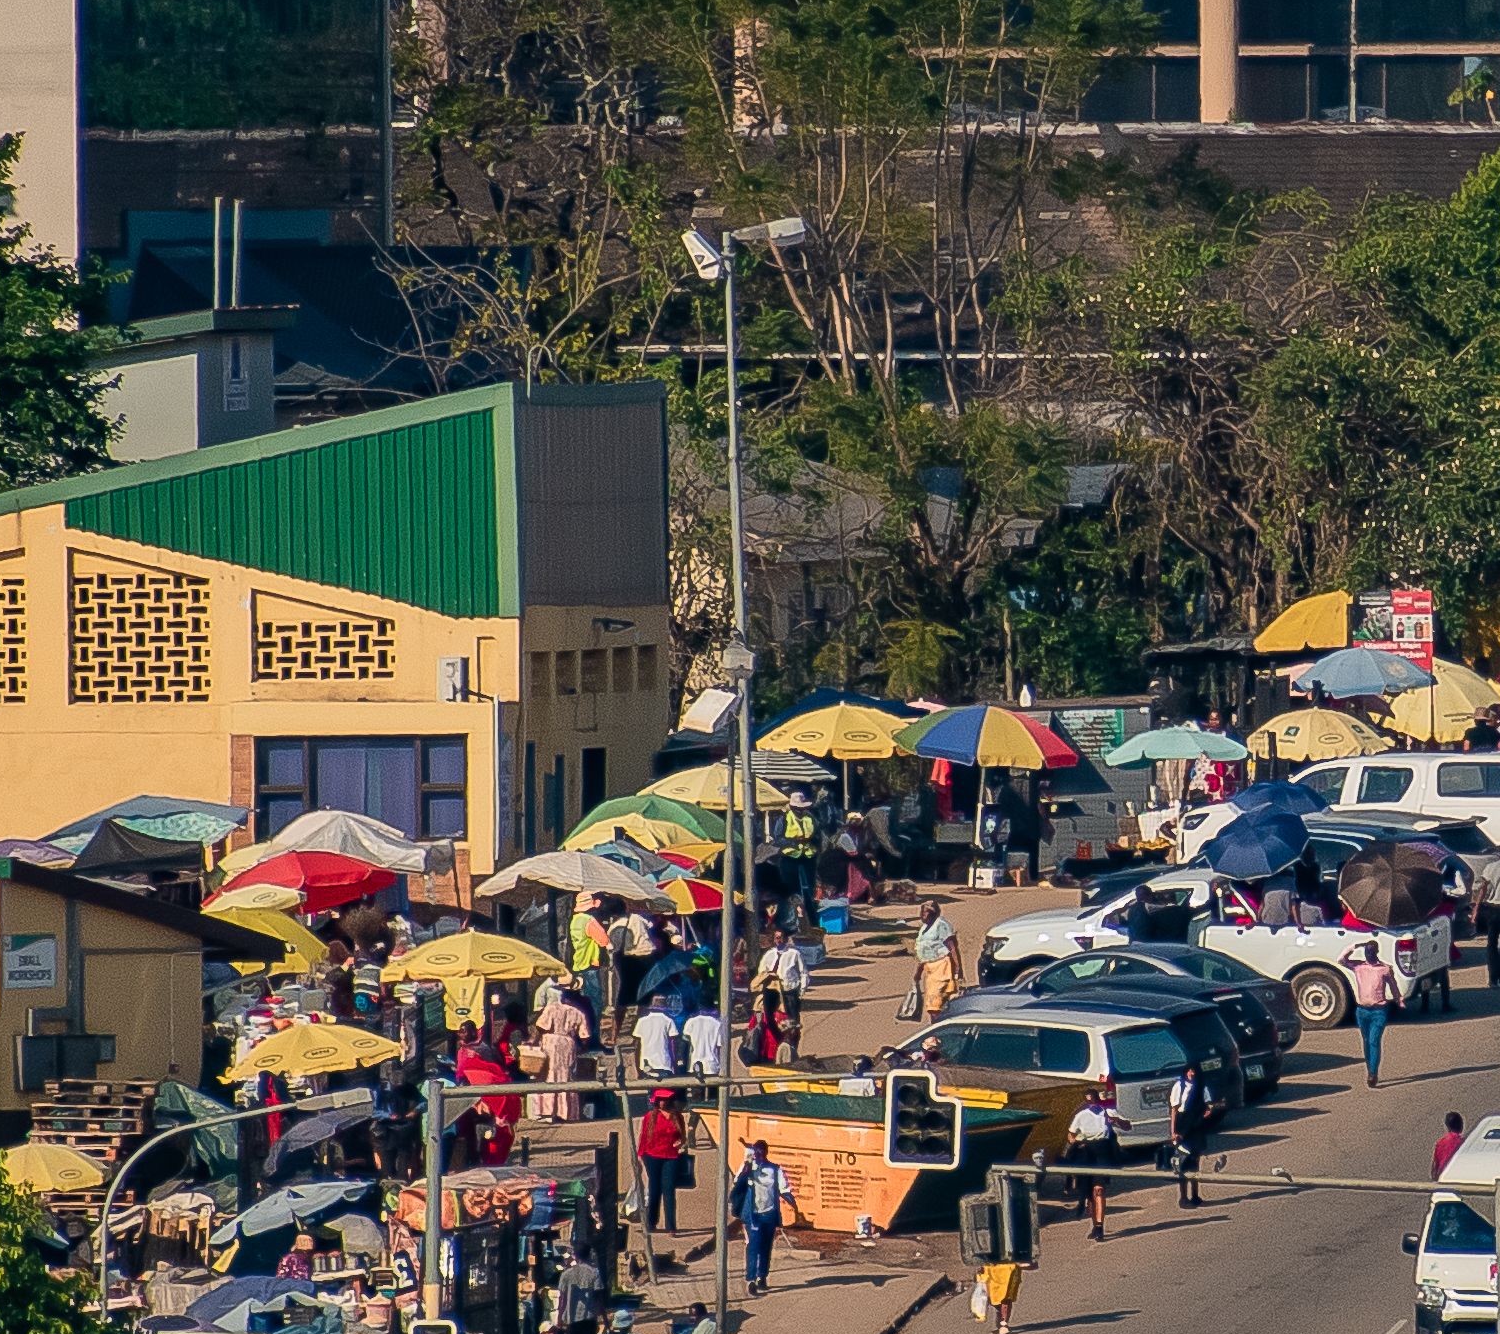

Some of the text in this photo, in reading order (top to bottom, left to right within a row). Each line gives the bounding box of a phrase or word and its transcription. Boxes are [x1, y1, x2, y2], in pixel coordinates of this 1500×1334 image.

[18, 955, 42, 967] SMALL
[8, 969, 53, 981] WORKSHOPS
[833, 1152, 857, 1166] NO
